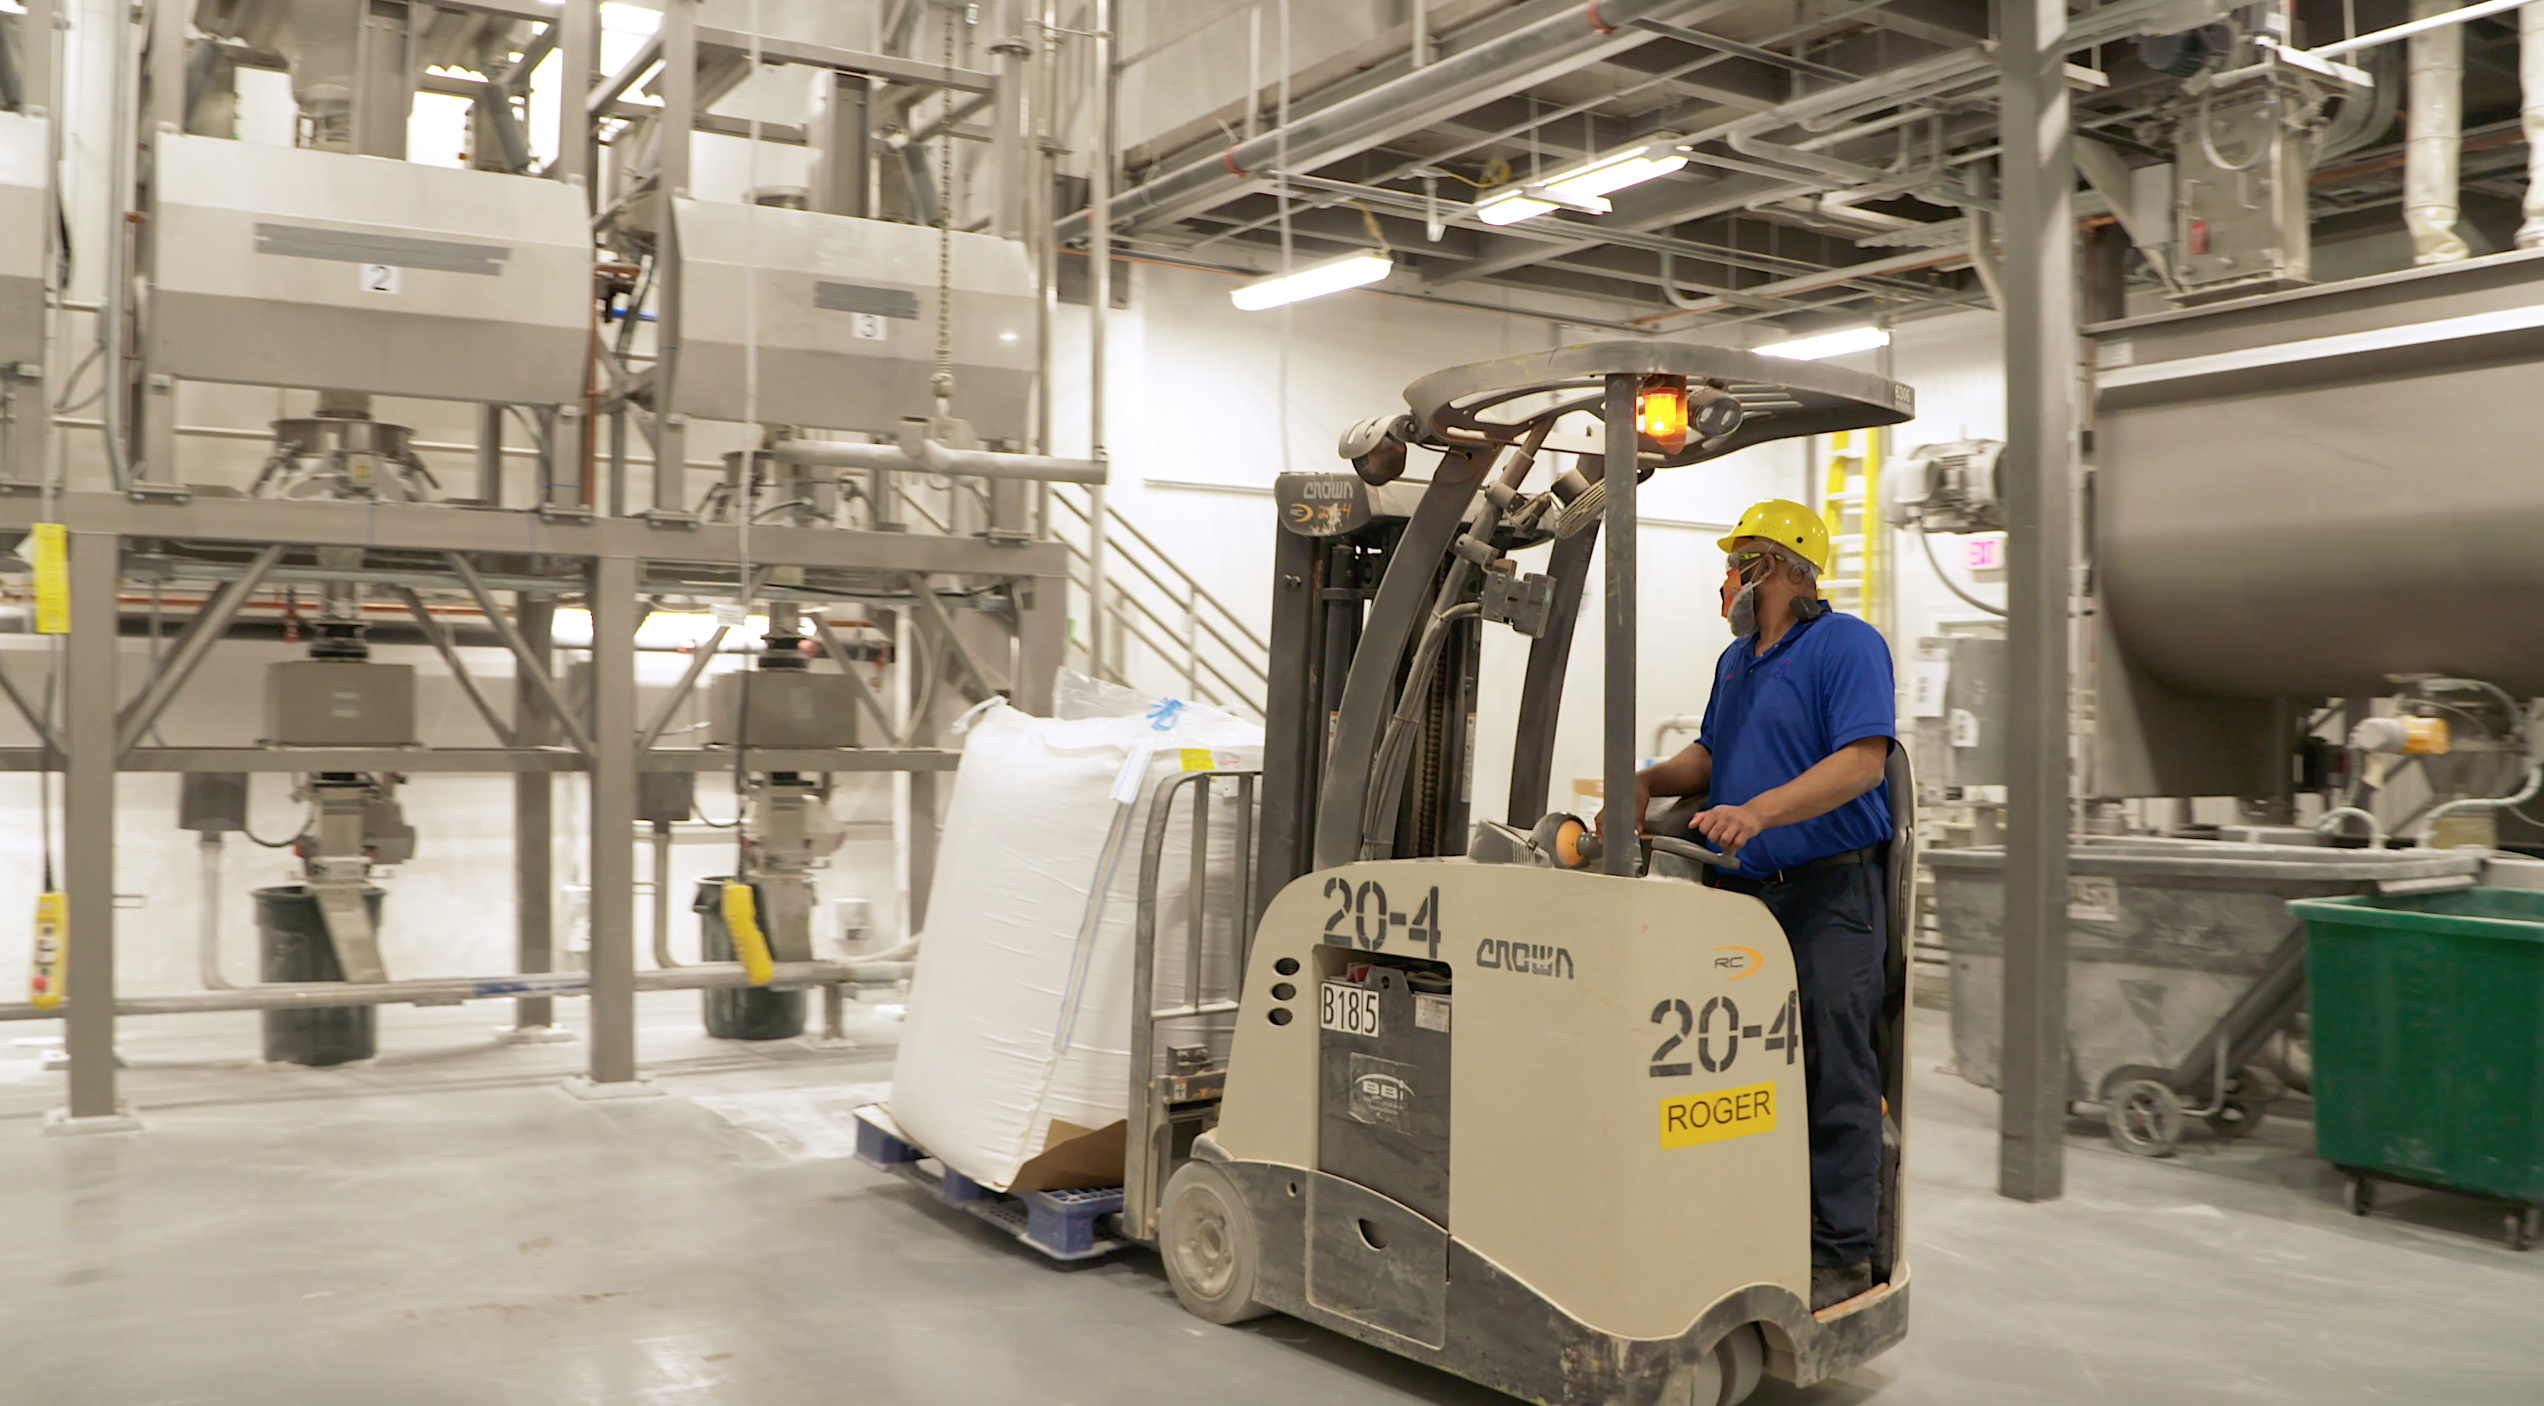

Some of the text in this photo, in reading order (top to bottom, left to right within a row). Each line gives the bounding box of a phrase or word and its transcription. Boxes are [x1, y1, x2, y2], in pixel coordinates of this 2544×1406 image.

[370, 266, 391, 290] 2
[860, 315, 878, 337] 3
[1303, 481, 1353, 499] CROWN
[1970, 541, 1995, 565] EXIT
[1323, 877, 1441, 959] 20-4
[1476, 938, 1574, 980] CROWN
[1714, 956, 1744, 969] RC
[1323, 986, 1376, 1033] B185
[1650, 989, 1799, 1077] 20-4
[1668, 1090, 1771, 1132] ROGER
